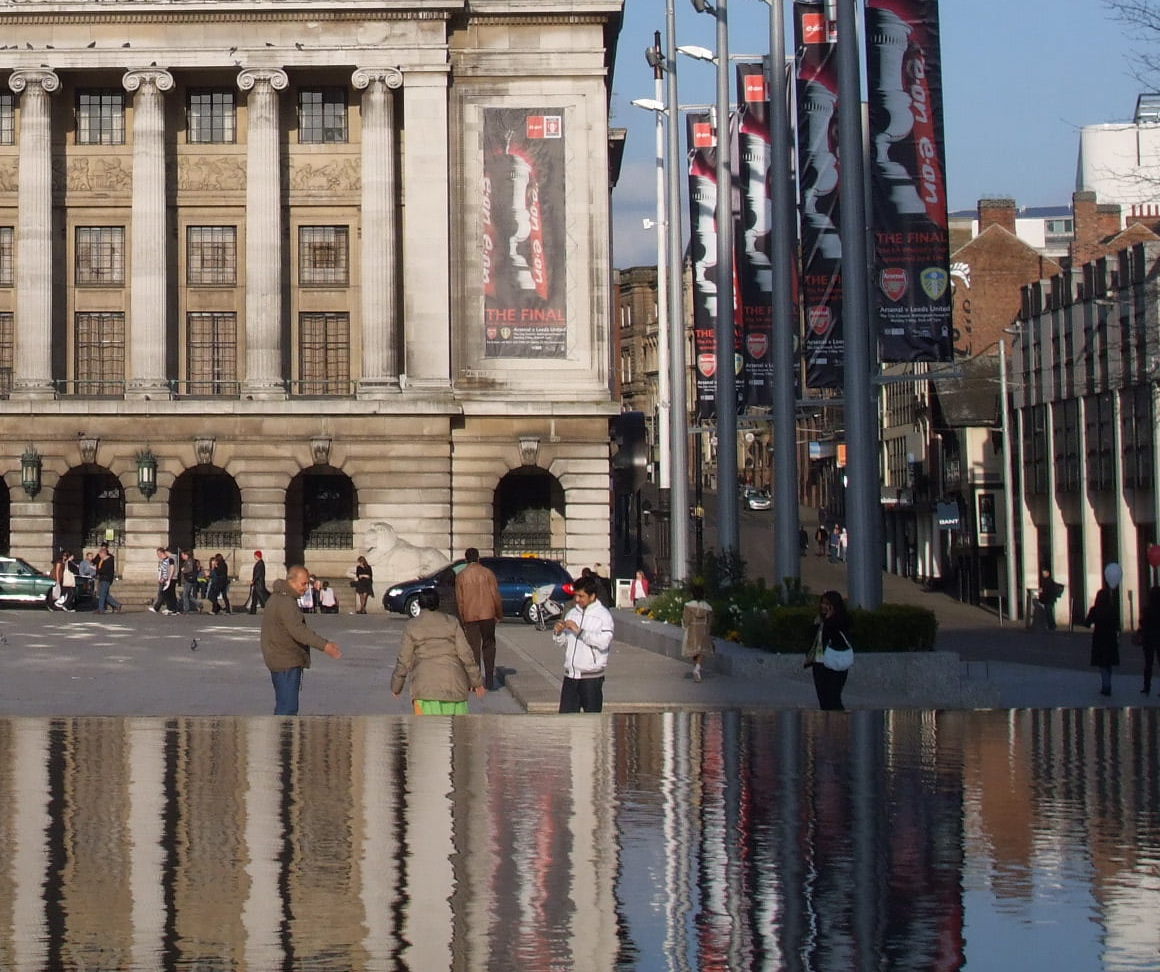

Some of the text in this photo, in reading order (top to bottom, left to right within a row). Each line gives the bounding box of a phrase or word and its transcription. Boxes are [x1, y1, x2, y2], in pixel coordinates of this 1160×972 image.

[877, 231, 947, 244] THE FINAL
[805, 275, 828, 285] THE
[486, 308, 566, 321] THE FINAL
[745, 306, 765, 314] THE
[695, 330, 715, 338] THE
